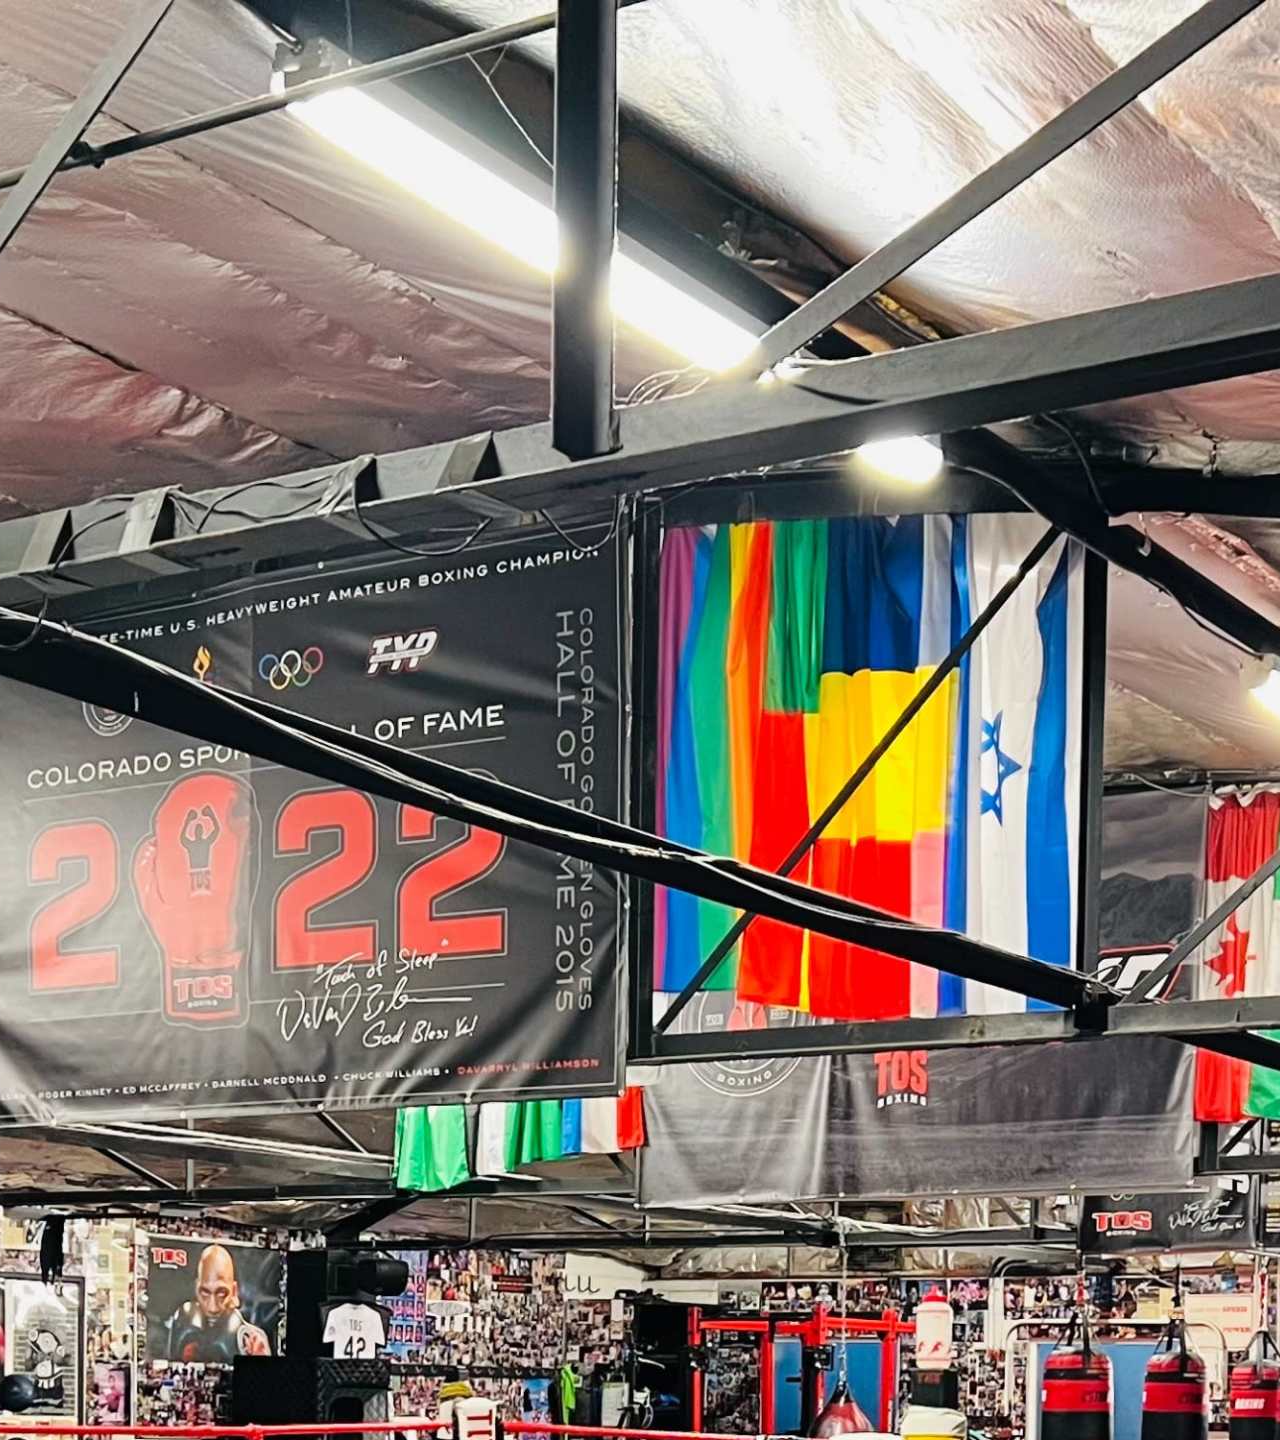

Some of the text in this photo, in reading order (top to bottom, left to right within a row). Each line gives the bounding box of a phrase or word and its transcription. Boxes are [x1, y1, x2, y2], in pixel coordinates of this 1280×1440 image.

[99, 625, 164, 643] EE-TIME
[170, 618, 201, 634] U.S.
[206, 592, 321, 626] HEAVYWEIGHT
[327, 577, 411, 603] AMATEUR
[419, 563, 489, 588] BOXING
[556, 610, 575, 717] HALL
[375, 705, 505, 742] OF FAME
[27, 750, 172, 789] COLORADO
[557, 730, 576, 785] OF
[578, 608, 595, 1011] COLORADO GOEN GLOVES
[556, 925, 574, 1012] 2015
[173, 975, 234, 1003] TOS
[362, 1021, 402, 1048] God
[75, 1087, 112, 1097] KINNEY
[122, 1085, 137, 1095] ED
[139, 1082, 201, 1093] MCCAFFREY
[212, 1077, 260, 1089] DARNELL
[263, 1073, 327, 1086] MCDONALD
[342, 1070, 382, 1082] CHUCK
[387, 1067, 441, 1079] WILLIAMS
[457, 1062, 519, 1077] DAVARRYL
[521, 1057, 601, 1072] WILLIAMSON
[717, 1070, 773, 1087] BOXING
[874, 1051, 929, 1096] TOS
[877, 1092, 927, 1109] BOXING
[1095, 1211, 1152, 1232] TOS
[150, 1247, 187, 1267] TOS
[344, 1336, 366, 1359] 42
[1234, 1398, 1265, 1410] BOXING
